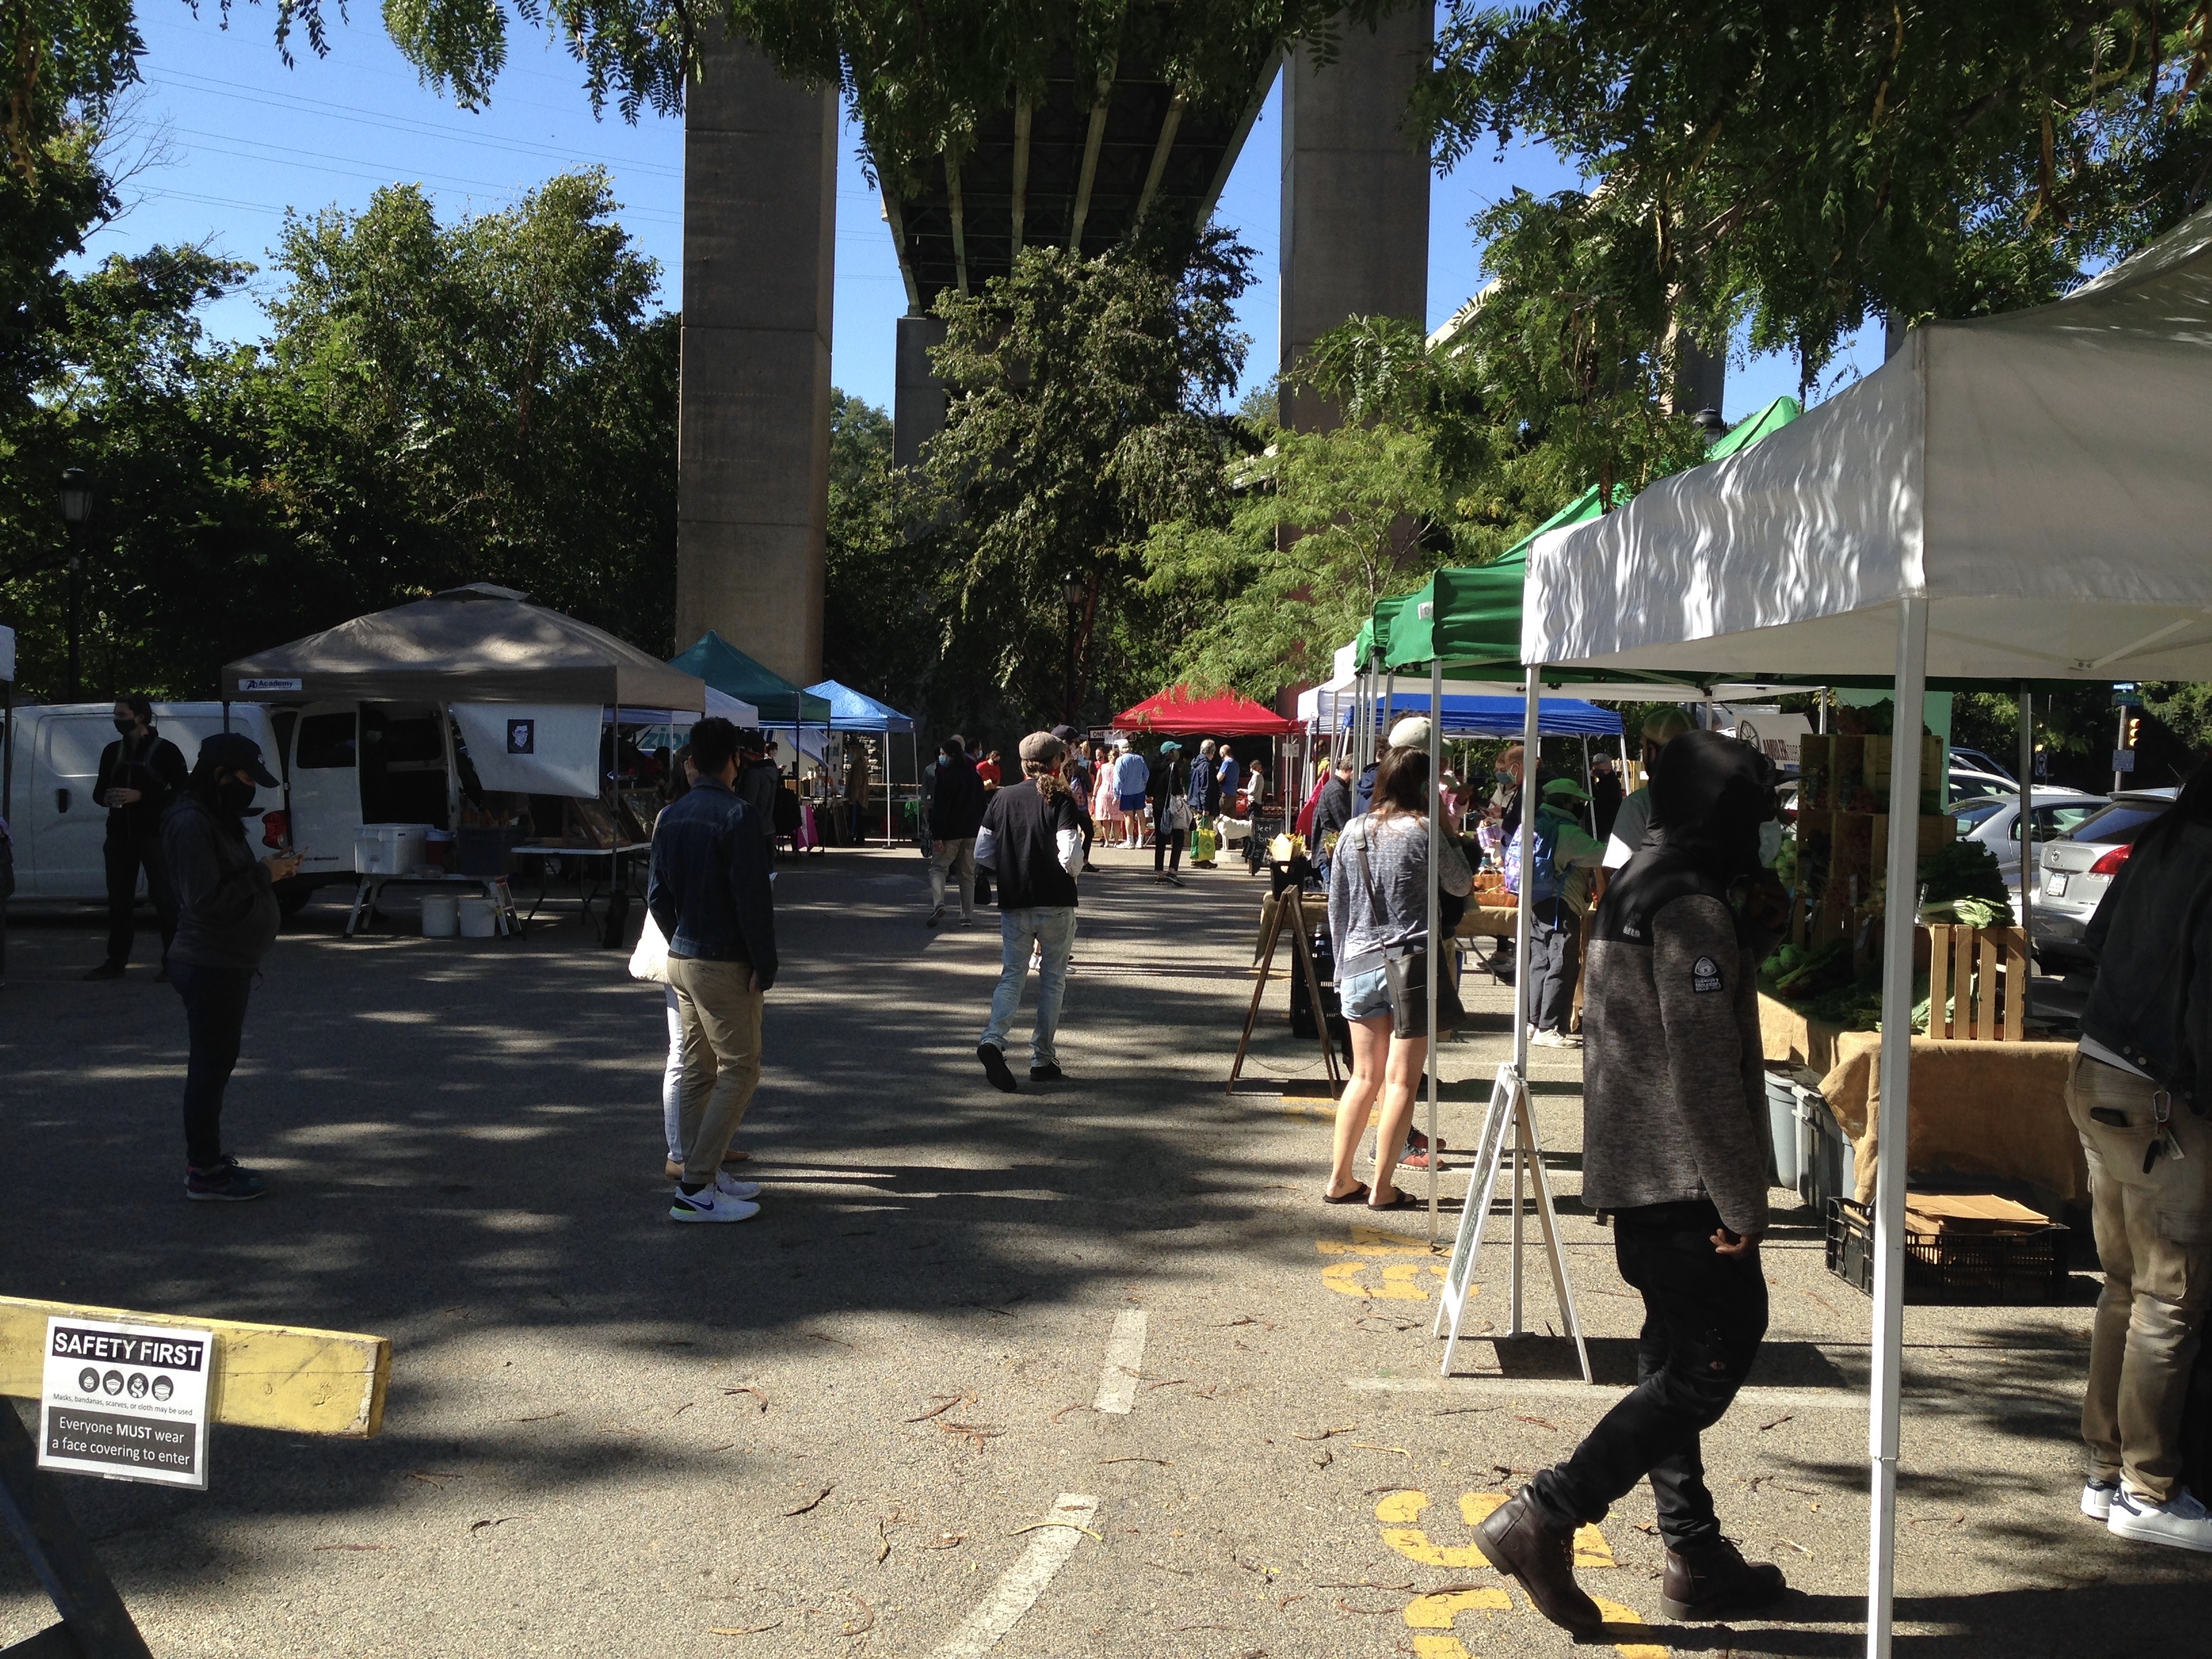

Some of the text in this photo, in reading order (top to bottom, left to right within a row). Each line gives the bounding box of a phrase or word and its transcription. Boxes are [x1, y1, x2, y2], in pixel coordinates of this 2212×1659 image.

[259, 680, 293, 688] Academy
[54, 1332, 202, 1367] SAFETY FIRST
[53, 1393, 74, 1402] Masks,
[74, 1395, 104, 1406] bandanas,
[105, 1401, 129, 1410] scarves,
[138, 1403, 153, 1411] cloth
[154, 1406, 167, 1414] may
[169, 1406, 177, 1414] be
[59, 1416, 185, 1444] Everyone MUST wear
[52, 1437, 191, 1466] a face covering to enter
